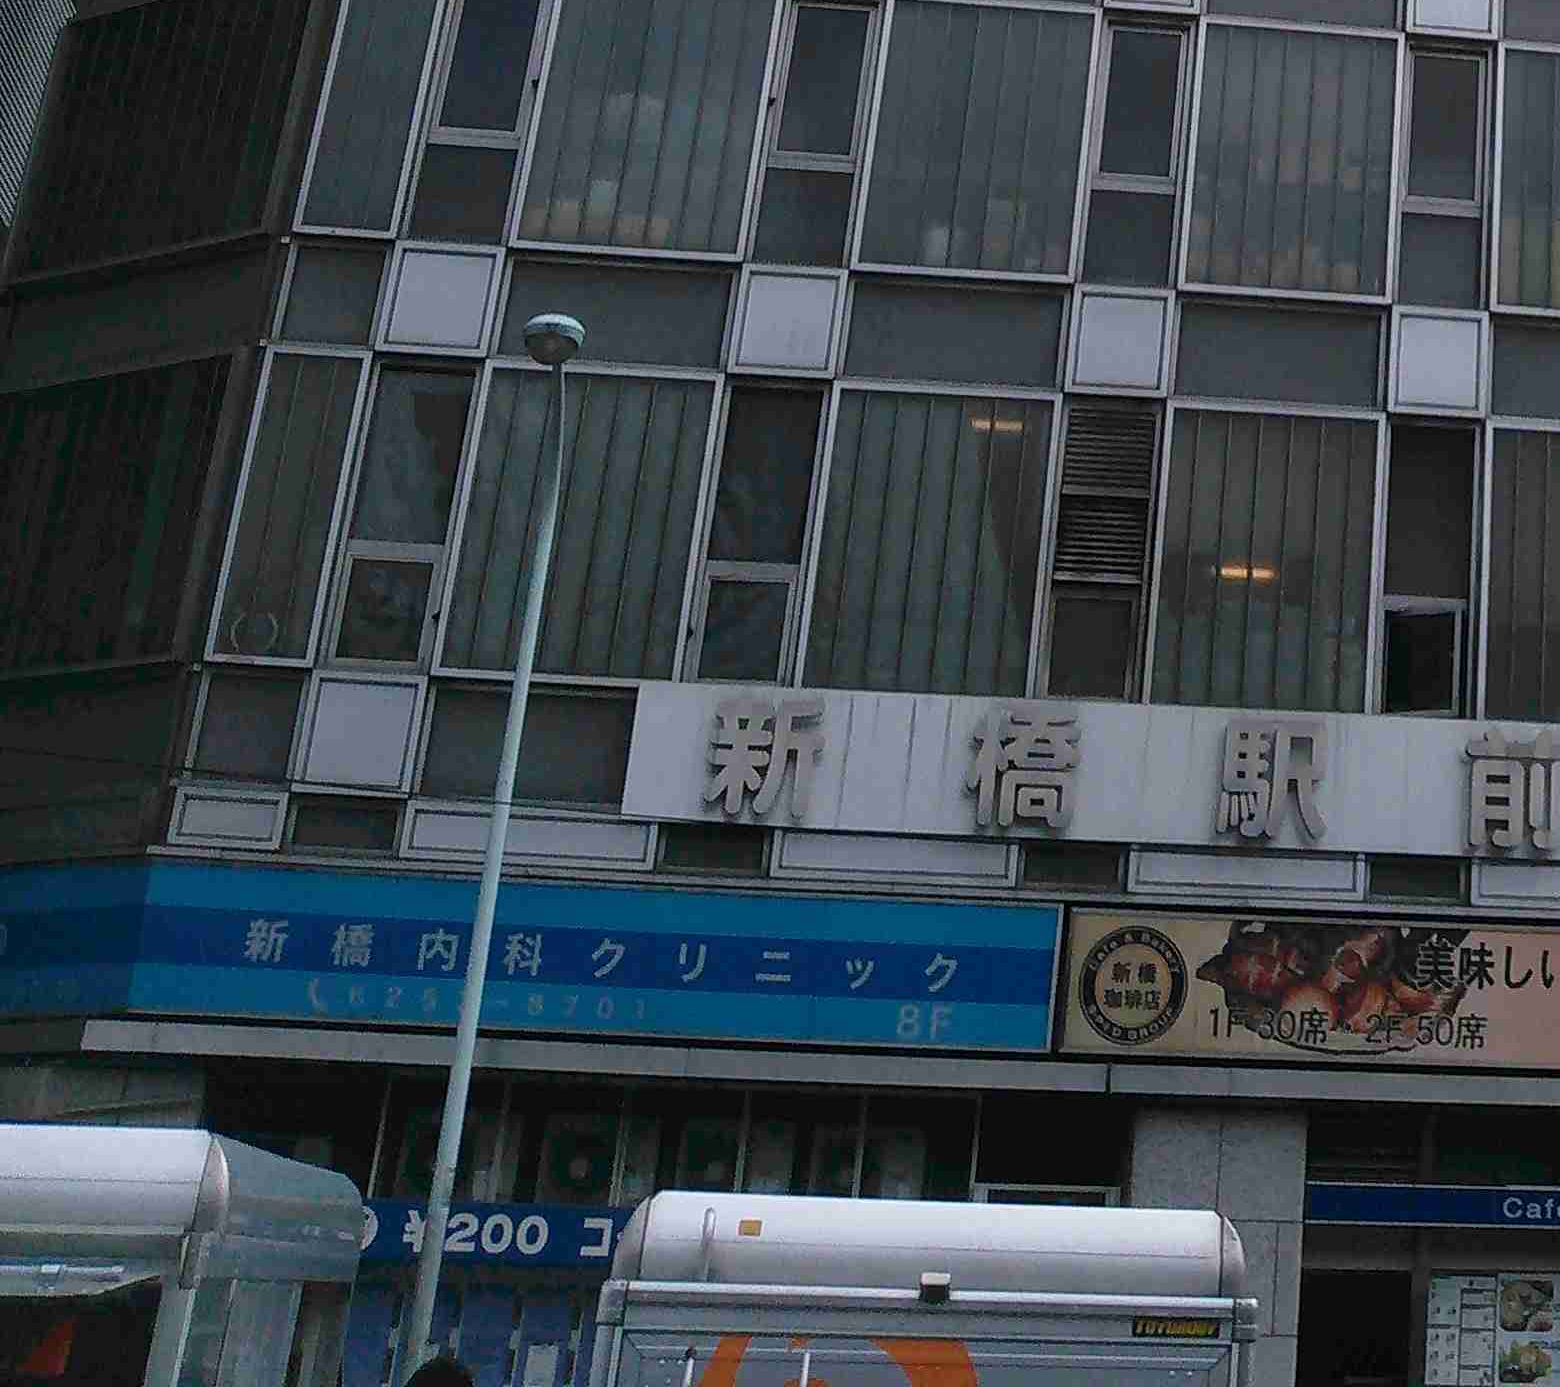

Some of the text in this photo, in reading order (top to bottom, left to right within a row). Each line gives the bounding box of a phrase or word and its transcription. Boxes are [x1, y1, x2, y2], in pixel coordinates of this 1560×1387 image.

[244, 918, 958, 993] 新橋内科クリニック
[896, 1003, 953, 1040] 8F
[1209, 1007, 1247, 1039] 1F
